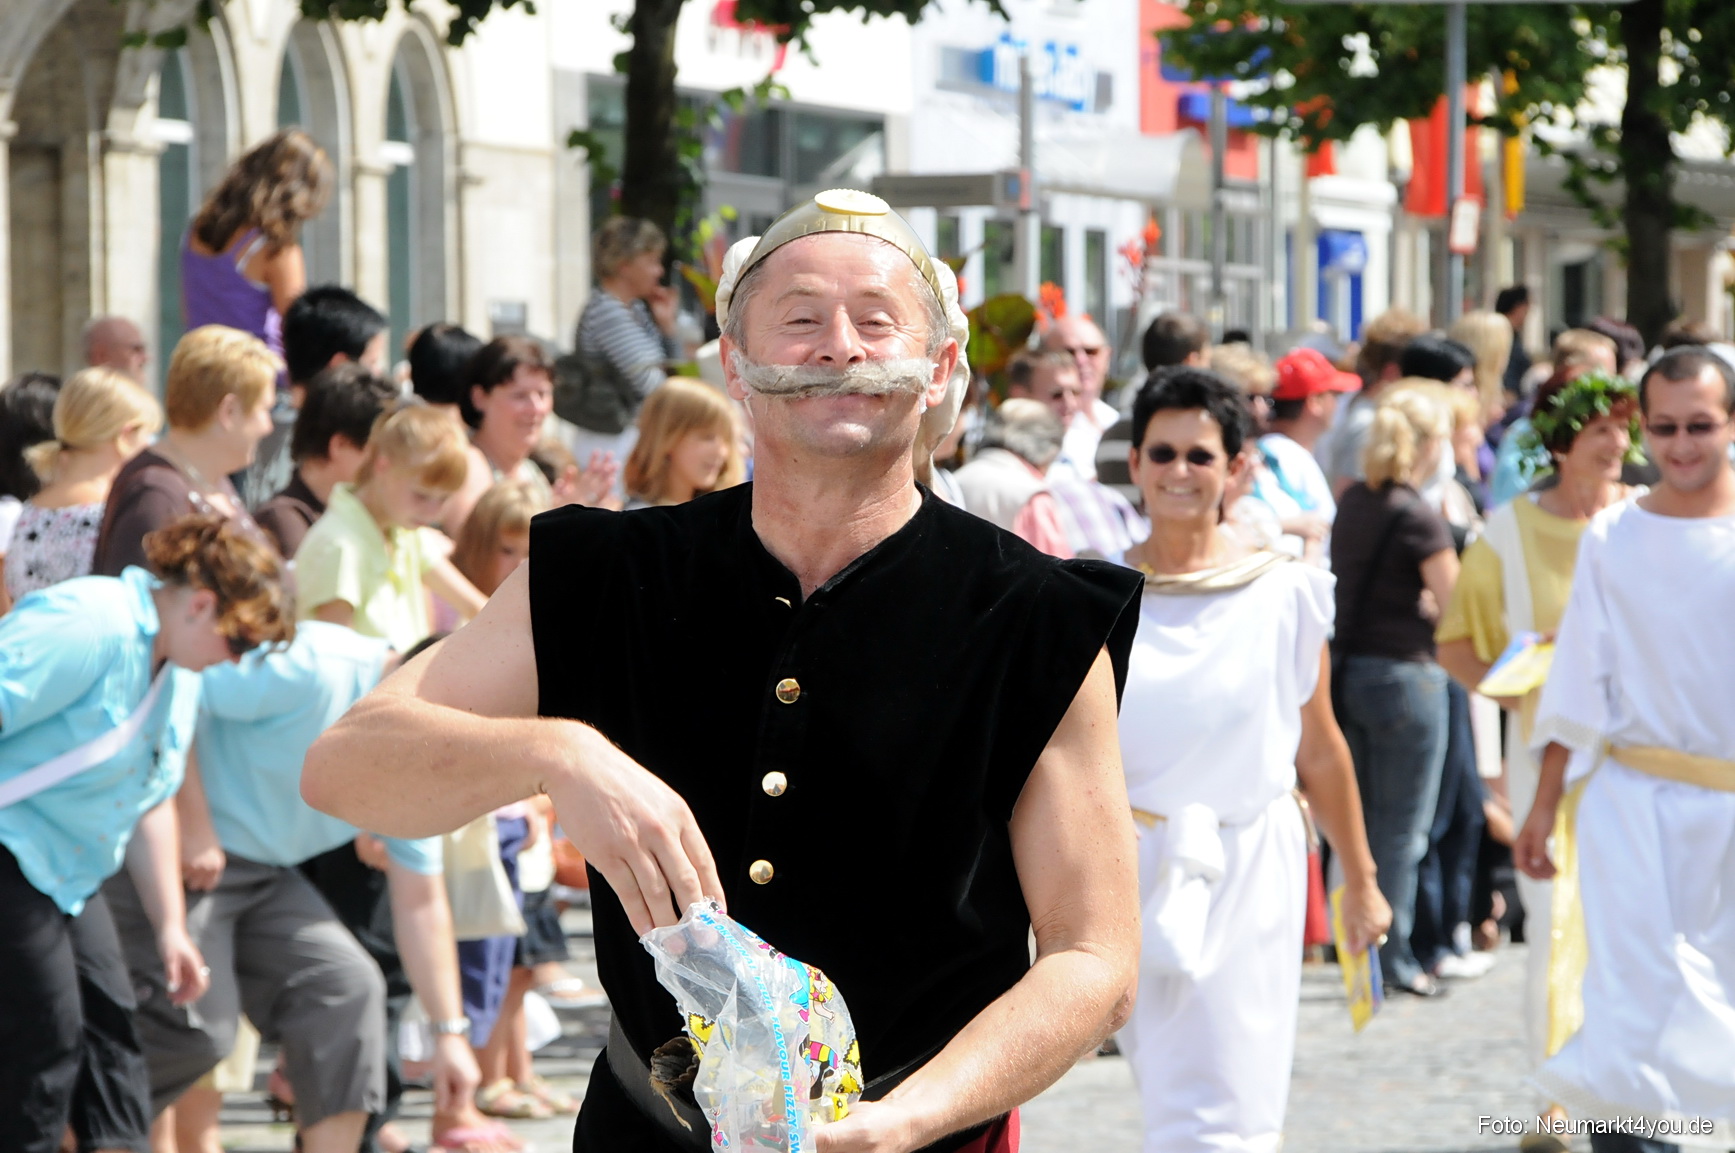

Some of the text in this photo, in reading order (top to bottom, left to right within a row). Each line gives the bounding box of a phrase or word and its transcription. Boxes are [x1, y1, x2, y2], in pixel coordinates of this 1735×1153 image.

[714, 924, 757, 969] ORIGINAL
[754, 976, 775, 1011] FRUIT
[770, 1016, 790, 1081] FLAVOUR
[783, 1086, 797, 1129] FIZZY
